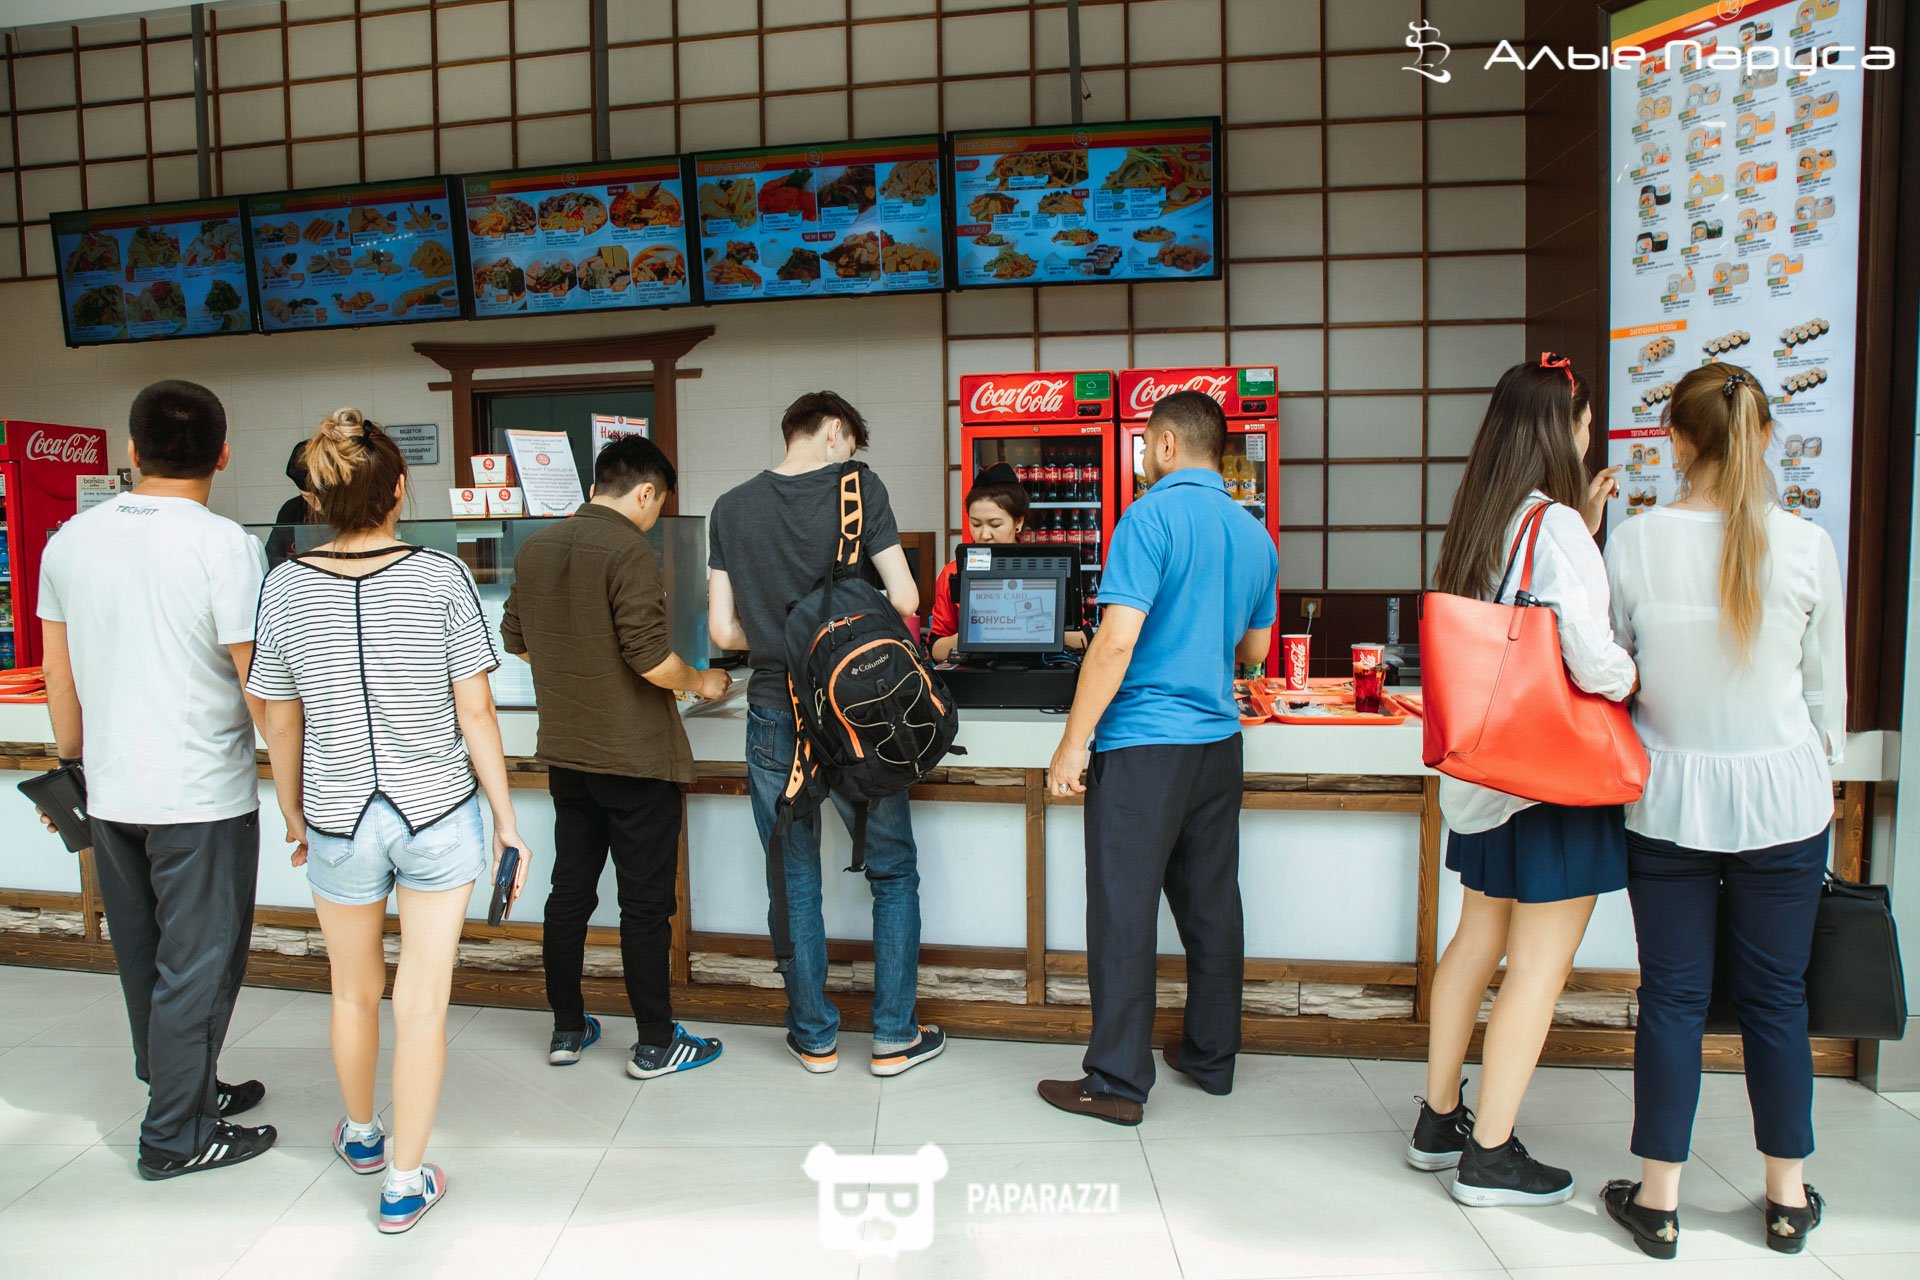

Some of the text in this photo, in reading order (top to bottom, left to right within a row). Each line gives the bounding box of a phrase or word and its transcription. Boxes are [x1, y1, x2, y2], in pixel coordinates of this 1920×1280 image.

[970, 379, 1069, 414] Coca-Cola
[26, 430, 99, 464] Coca-Cola
[115, 505, 159, 516] TECHFIT
[1004, 592, 1027, 600] CARD
[970, 615, 1016, 625] БОНУСЫ
[858, 653, 890, 672] Columbia
[1290, 641, 1306, 689] Coca-Cola
[425, 1175, 436, 1195] N
